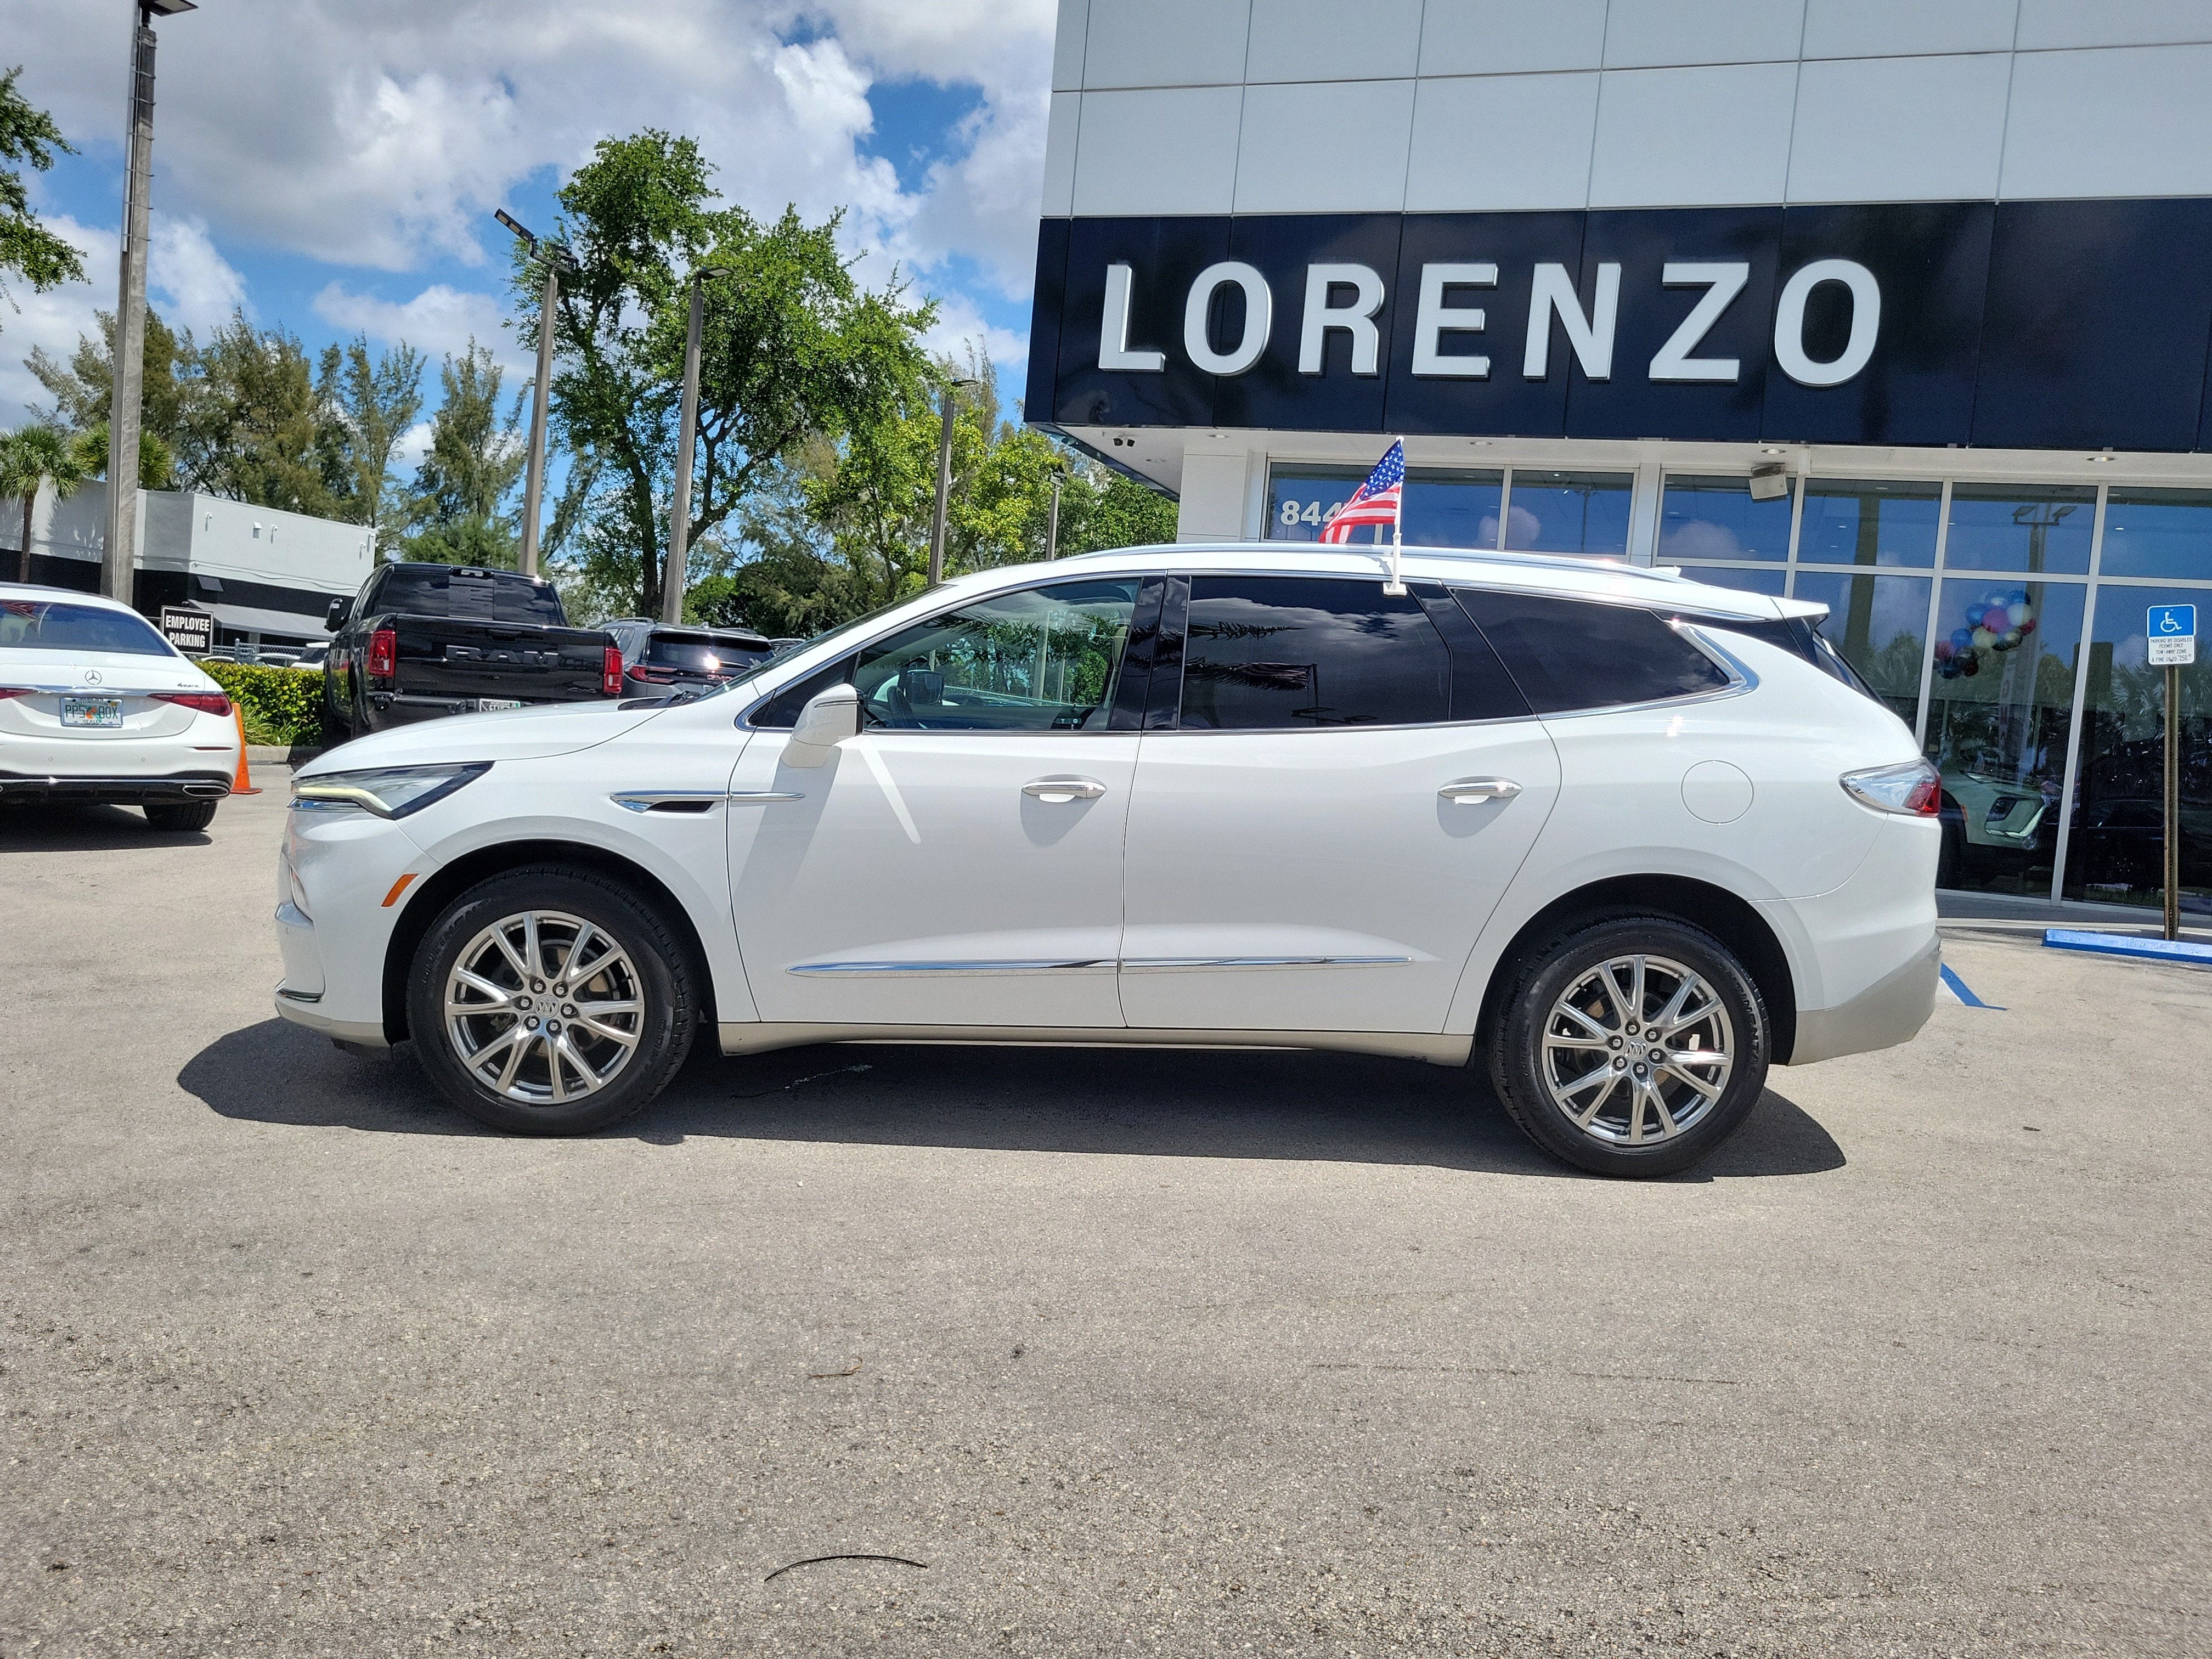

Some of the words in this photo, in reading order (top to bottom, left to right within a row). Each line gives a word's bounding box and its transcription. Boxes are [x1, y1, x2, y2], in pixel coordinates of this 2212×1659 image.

[1098, 259, 1881, 386] LORENZO
[166, 615, 210, 631] EMPLOYEE
[169, 632, 205, 647] PARKING
[446, 645, 558, 667] RAM
